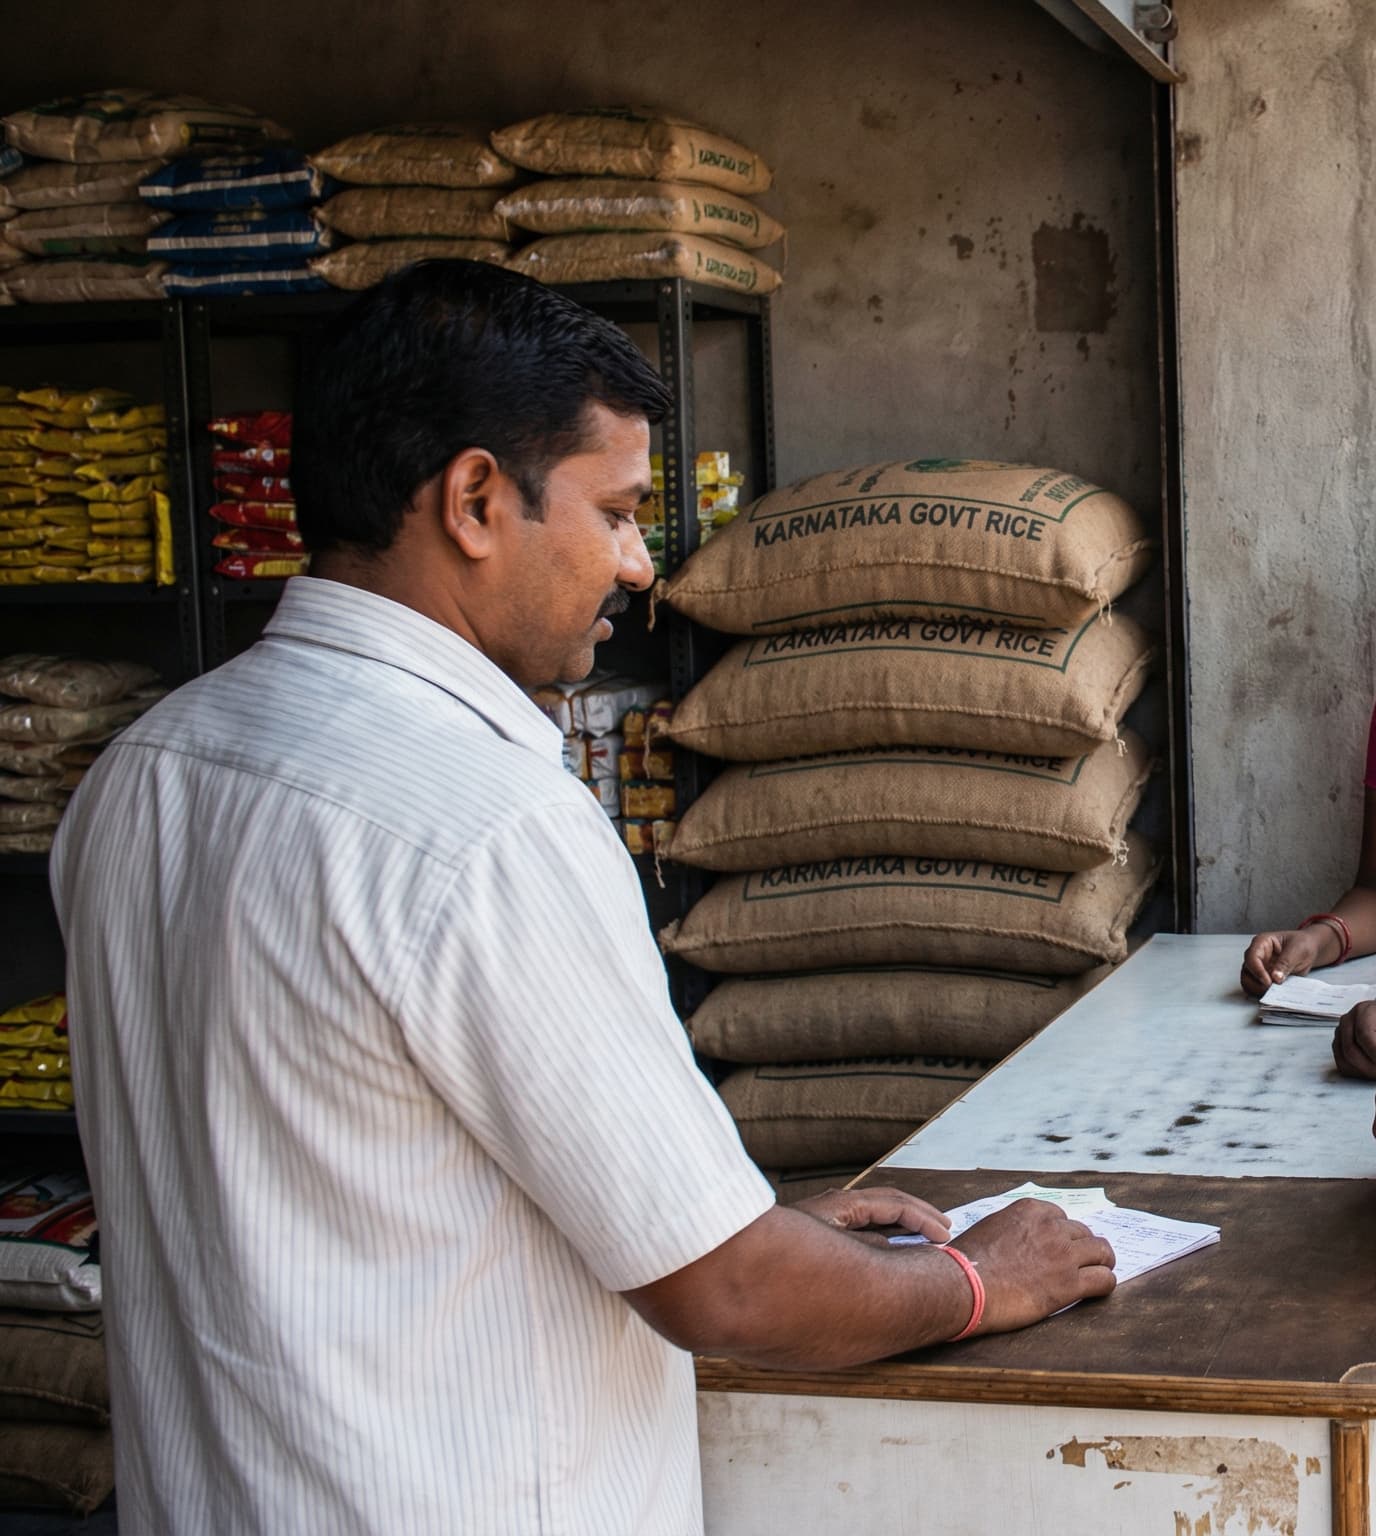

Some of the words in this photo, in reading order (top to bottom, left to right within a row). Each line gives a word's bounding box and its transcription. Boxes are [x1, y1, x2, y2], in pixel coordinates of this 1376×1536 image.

[754, 502, 901, 548] KARNATAKA
[909, 502, 982, 530] GOVT
[985, 510, 1046, 542] RICE
[763, 619, 910, 655] KARNATAKA
[920, 621, 990, 646] GOVT
[995, 630, 1057, 658] RICE
[760, 855, 905, 888] KARNATAKA
[915, 858, 985, 878] GOVT
[990, 863, 1050, 889] RICE
